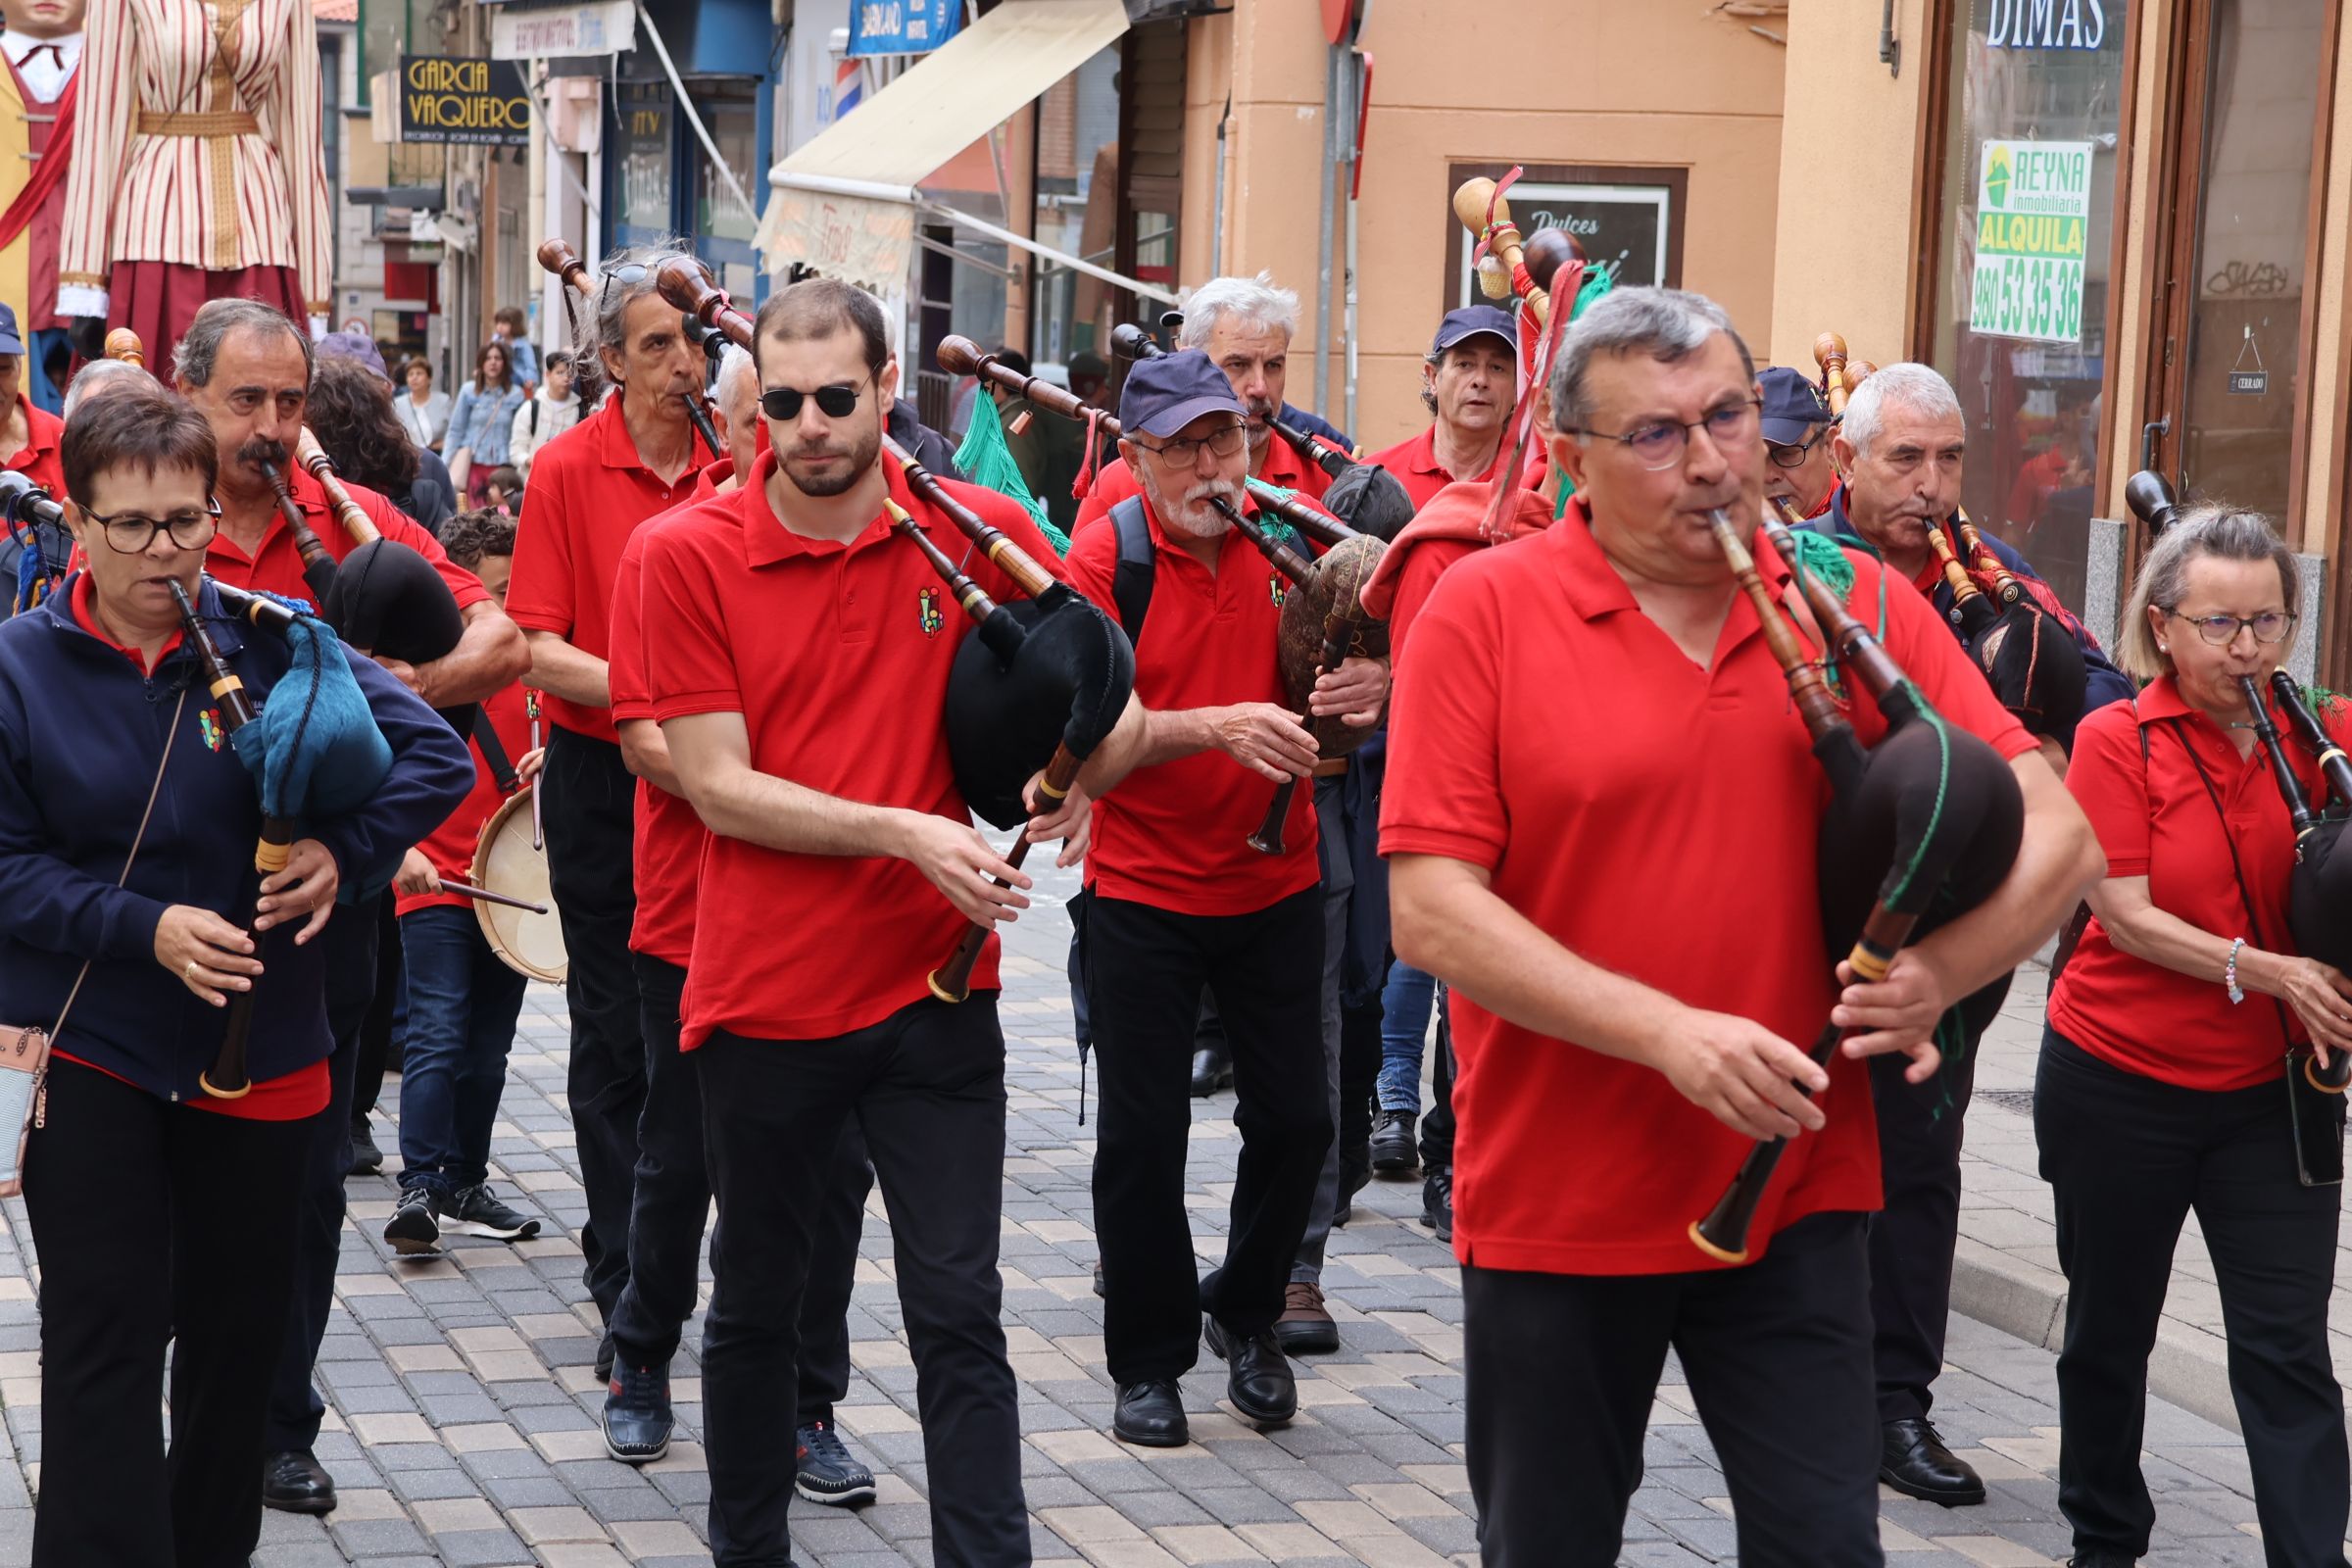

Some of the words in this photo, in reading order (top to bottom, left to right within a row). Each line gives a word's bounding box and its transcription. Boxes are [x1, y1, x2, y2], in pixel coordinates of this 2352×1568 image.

[1986, 0, 2104, 49] DIMAS
[409, 93, 530, 129] VAQUERO
[2015, 151, 2084, 192] REYNA
[1532, 211, 1599, 234] Dulces
[2014, 194, 2082, 213] inmobiliaria
[1980, 214, 2083, 254] ALQUILA
[1974, 267, 1998, 329] 980
[2000, 258, 2025, 333] 53
[2028, 259, 2053, 336] 35
[2055, 261, 2081, 339] 36
[2237, 377, 2264, 390] CERRADO
